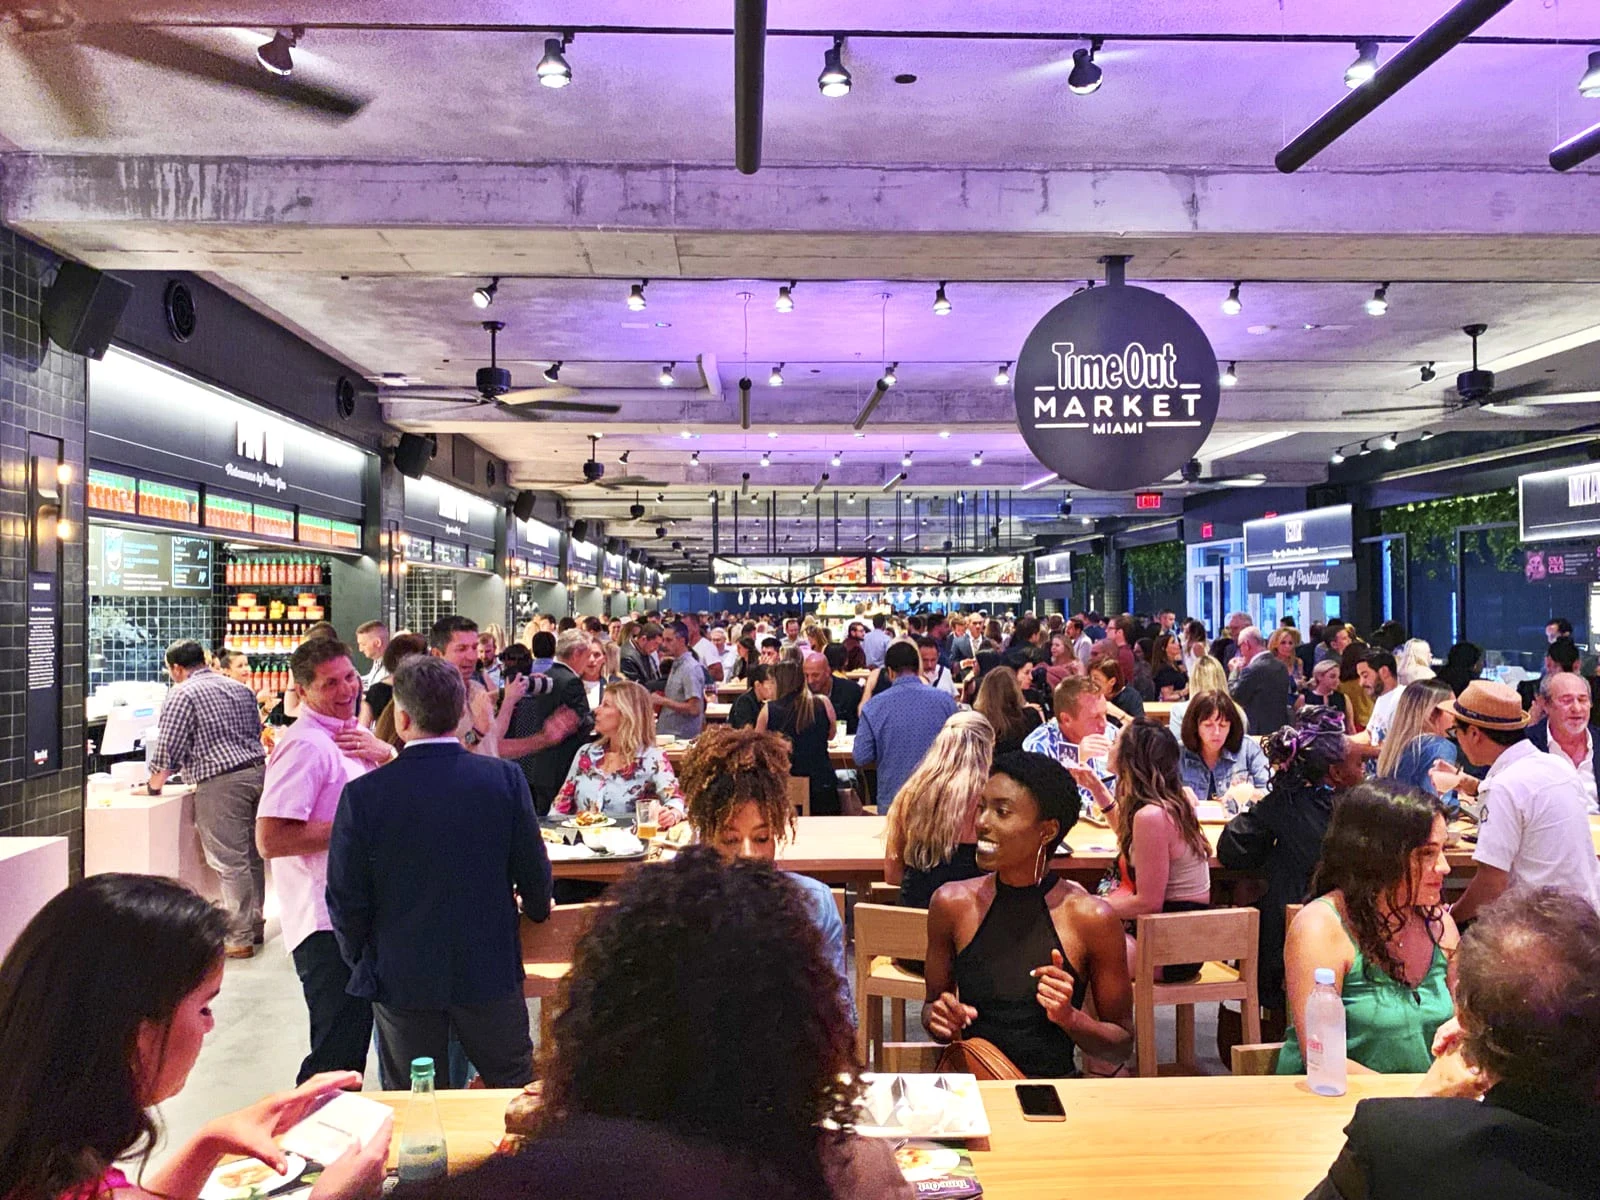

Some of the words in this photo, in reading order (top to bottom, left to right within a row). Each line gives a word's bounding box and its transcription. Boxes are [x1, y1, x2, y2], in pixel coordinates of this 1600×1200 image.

[1034, 394, 1201, 418] MARKET
[1093, 422, 1143, 434] MIAMI
[1267, 571, 1287, 587] Wines
[1287, 570, 1296, 591] of
[1297, 568, 1330, 590] Portugal
